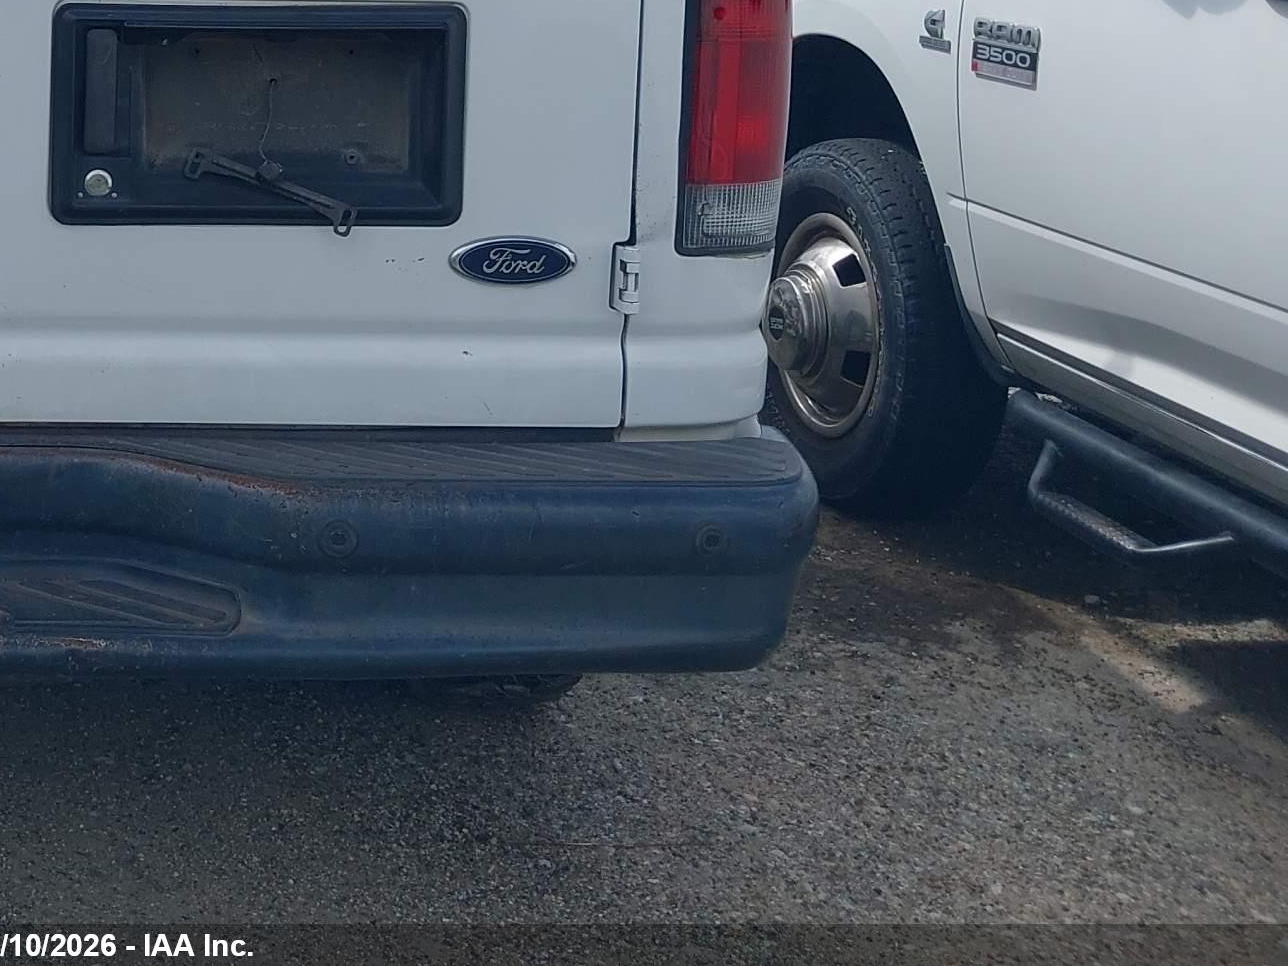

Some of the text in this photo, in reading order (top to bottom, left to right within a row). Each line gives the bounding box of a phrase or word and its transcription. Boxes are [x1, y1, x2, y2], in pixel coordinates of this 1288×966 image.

[973, 17, 1041, 52] RAM
[975, 43, 1031, 68] 3500
[482, 247, 547, 274] Ford
